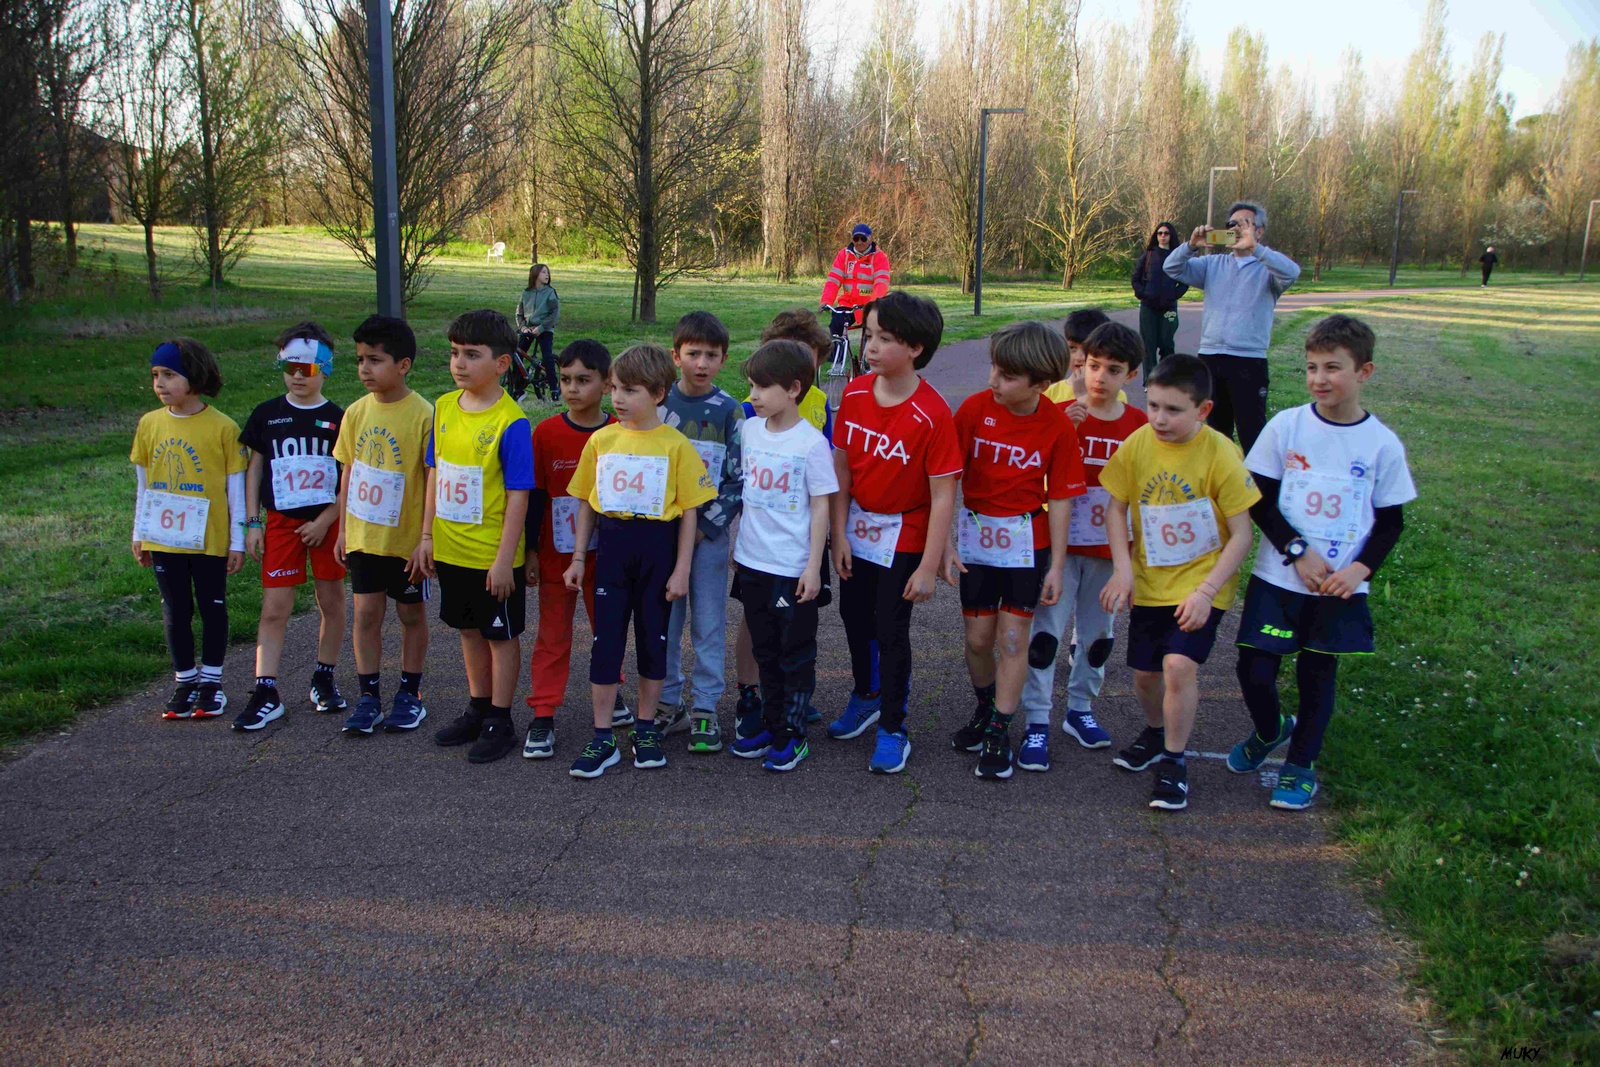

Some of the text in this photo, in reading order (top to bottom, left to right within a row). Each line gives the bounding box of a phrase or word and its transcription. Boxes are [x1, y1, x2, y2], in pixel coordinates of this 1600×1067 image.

[268, 417, 293, 426] macron
[1085, 436, 1124, 458] TT
[283, 469, 325, 492] 122
[438, 476, 468, 505] 115
[612, 469, 645, 494] 64
[751, 465, 791, 494] 104
[357, 480, 383, 506] 60
[1305, 491, 1342, 519] 93
[160, 508, 187, 532] 61
[565, 512, 577, 534] 1
[1090, 503, 1105, 528] 8
[979, 526, 1011, 549] 86
[1161, 521, 1196, 547] 63
